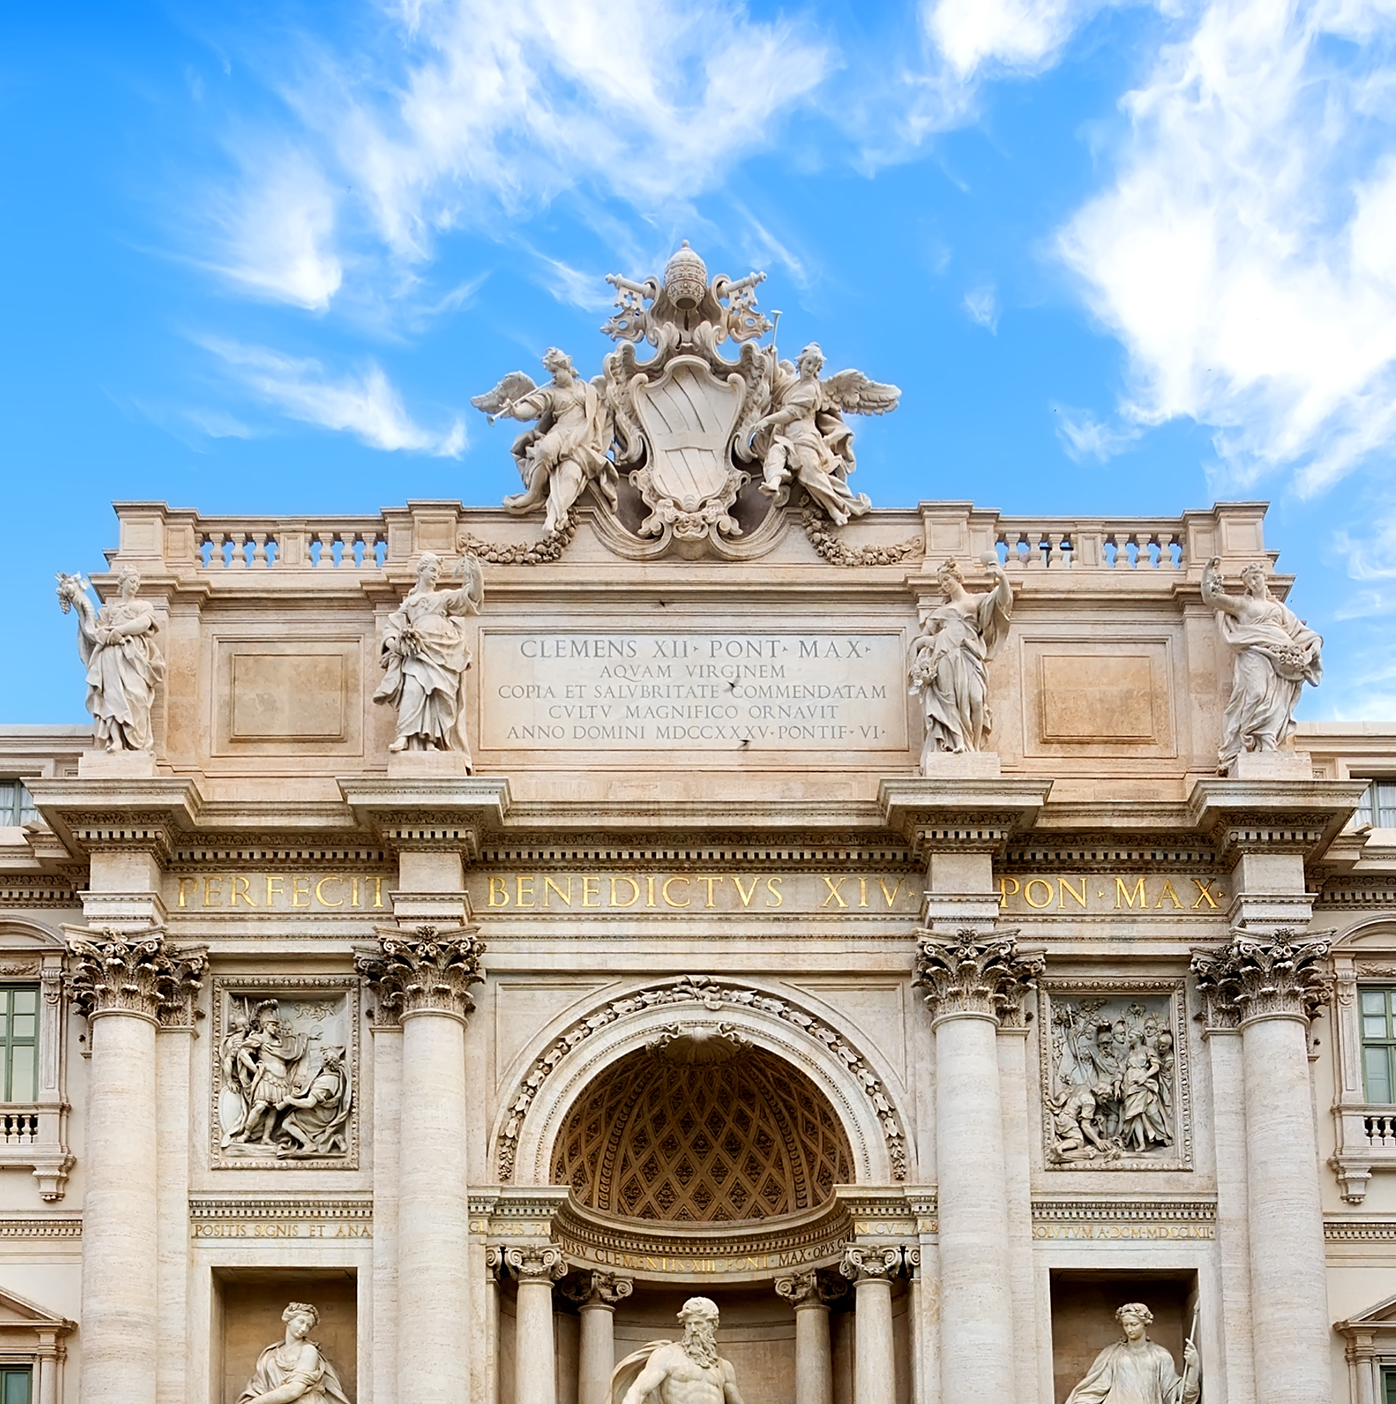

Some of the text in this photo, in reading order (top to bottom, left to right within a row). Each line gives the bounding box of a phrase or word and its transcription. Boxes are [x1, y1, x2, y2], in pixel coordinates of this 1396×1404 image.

[520, 639, 637, 659] CLEMENS
[599, 664, 786, 682] AQVAM VIRGINEM
[498, 684, 887, 699] COPIA ET SALVBRITATE COMMENDATAM
[548, 705, 839, 719] CVLTV MAGNIFICO ORNAVIT
[506, 725, 565, 740] ANNO
[572, 725, 646, 740] DOMINI
[177, 876, 391, 909] PERFECIT
[486, 876, 784, 909] BENEDICTVS
[195, 1224, 371, 1237] POSITIS SIGNIS ET ANA
